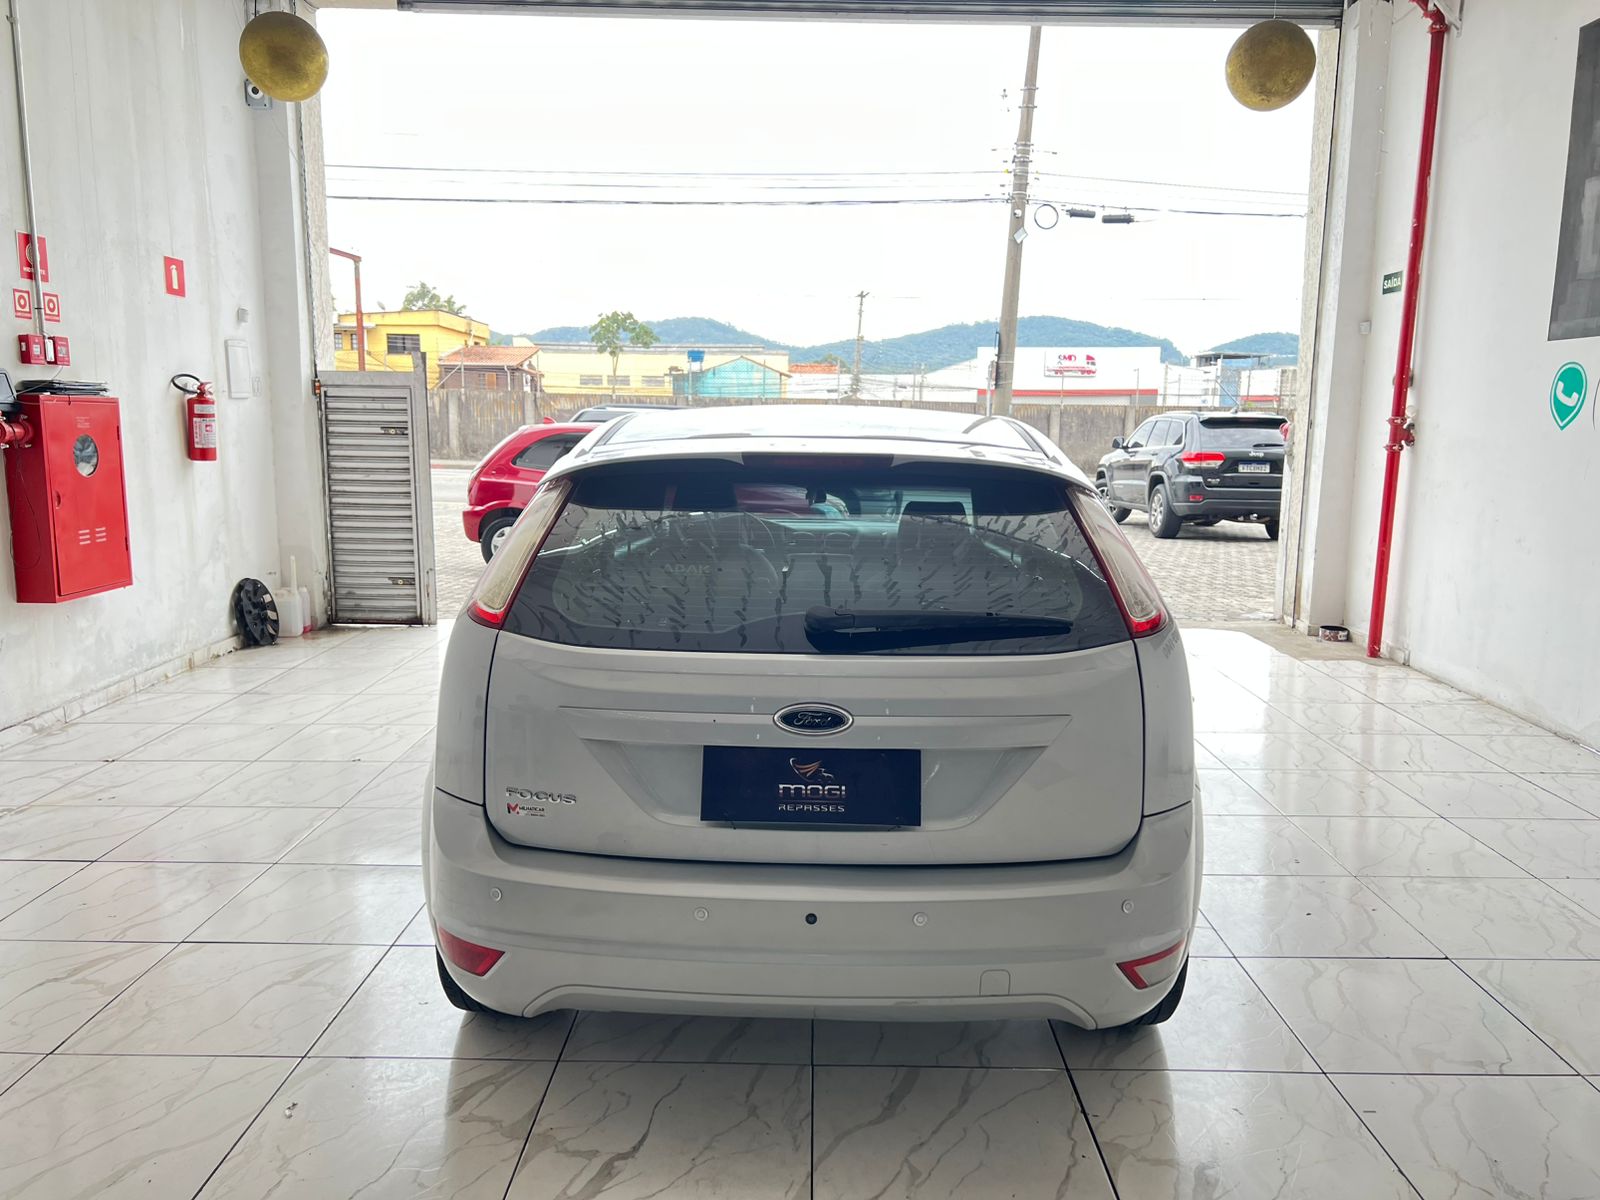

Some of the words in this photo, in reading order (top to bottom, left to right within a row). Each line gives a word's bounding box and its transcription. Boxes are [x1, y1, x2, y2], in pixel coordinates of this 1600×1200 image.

[1383, 276, 1401, 289] SAÍDA
[793, 711, 833, 727] Ford
[505, 786, 577, 805] FOCUS
[778, 784, 846, 799] MOGI
[778, 803, 846, 813] REPASSES
